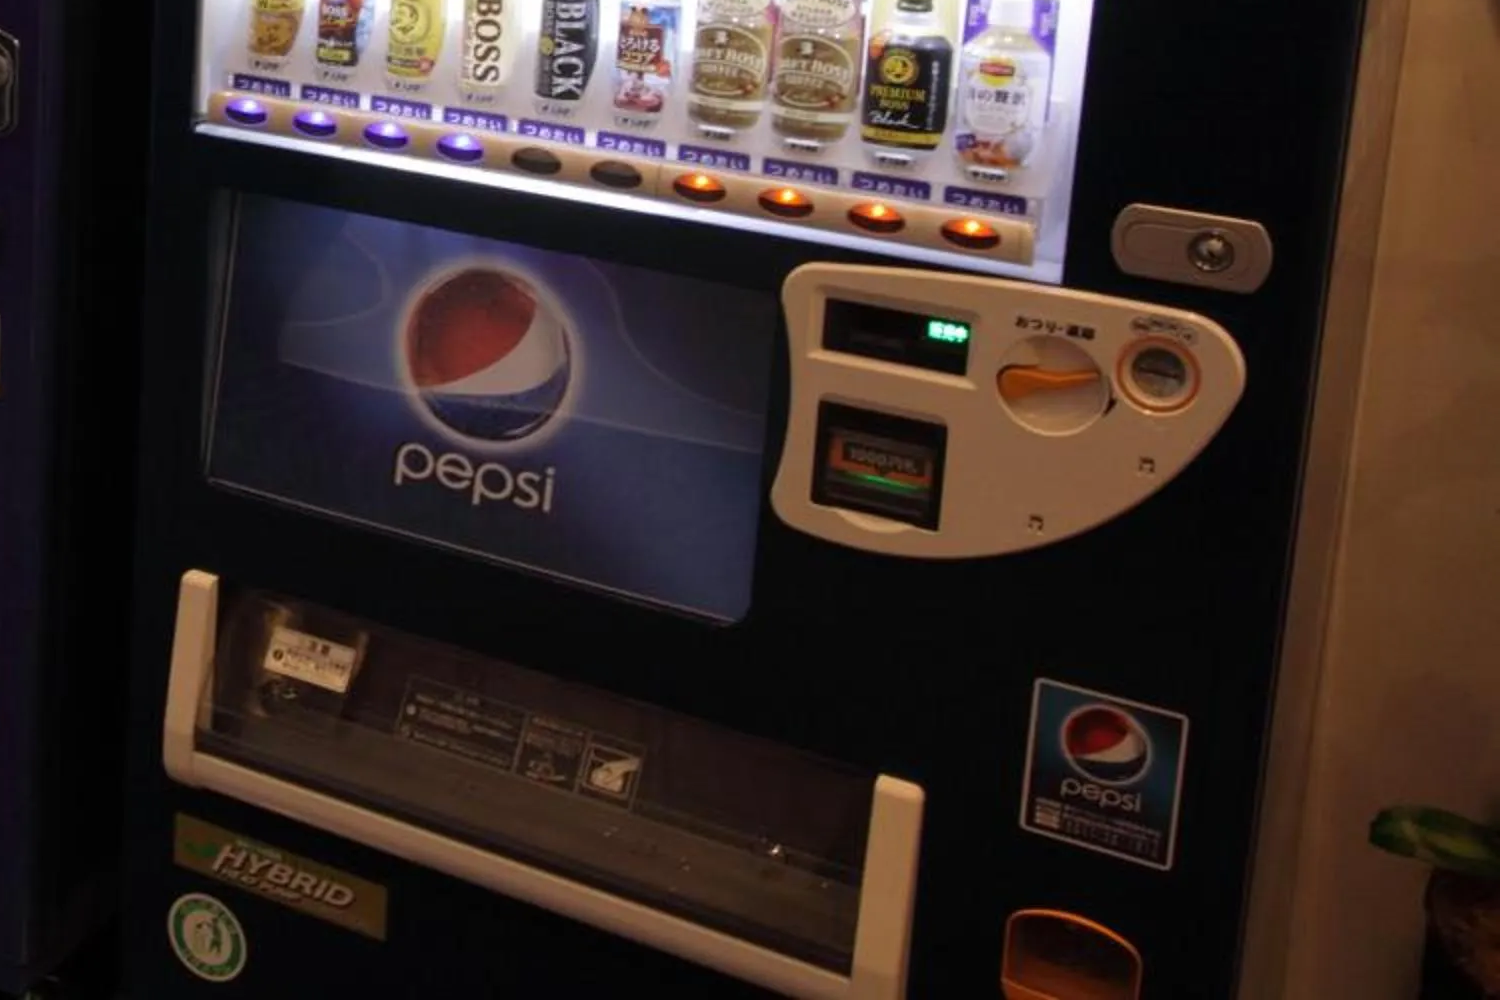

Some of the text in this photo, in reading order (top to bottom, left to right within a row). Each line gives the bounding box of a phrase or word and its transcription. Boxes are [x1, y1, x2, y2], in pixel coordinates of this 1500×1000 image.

[240, 79, 286, 94] つめたい
[869, 86, 926, 102] PREMIUM
[307, 90, 355, 105] つめたい
[378, 101, 429, 117] つめたい
[449, 112, 503, 130] つめたい
[524, 125, 580, 141] つめたい
[602, 136, 661, 154] つめたい
[684, 150, 744, 168] つめたい
[769, 164, 832, 179] つめたい
[857, 178, 926, 196] つめたい
[950, 191, 1021, 211] つめたい
[393, 443, 556, 513] pepsi
[1060, 777, 1142, 812] pepsi
[212, 844, 356, 908] HYBRID
